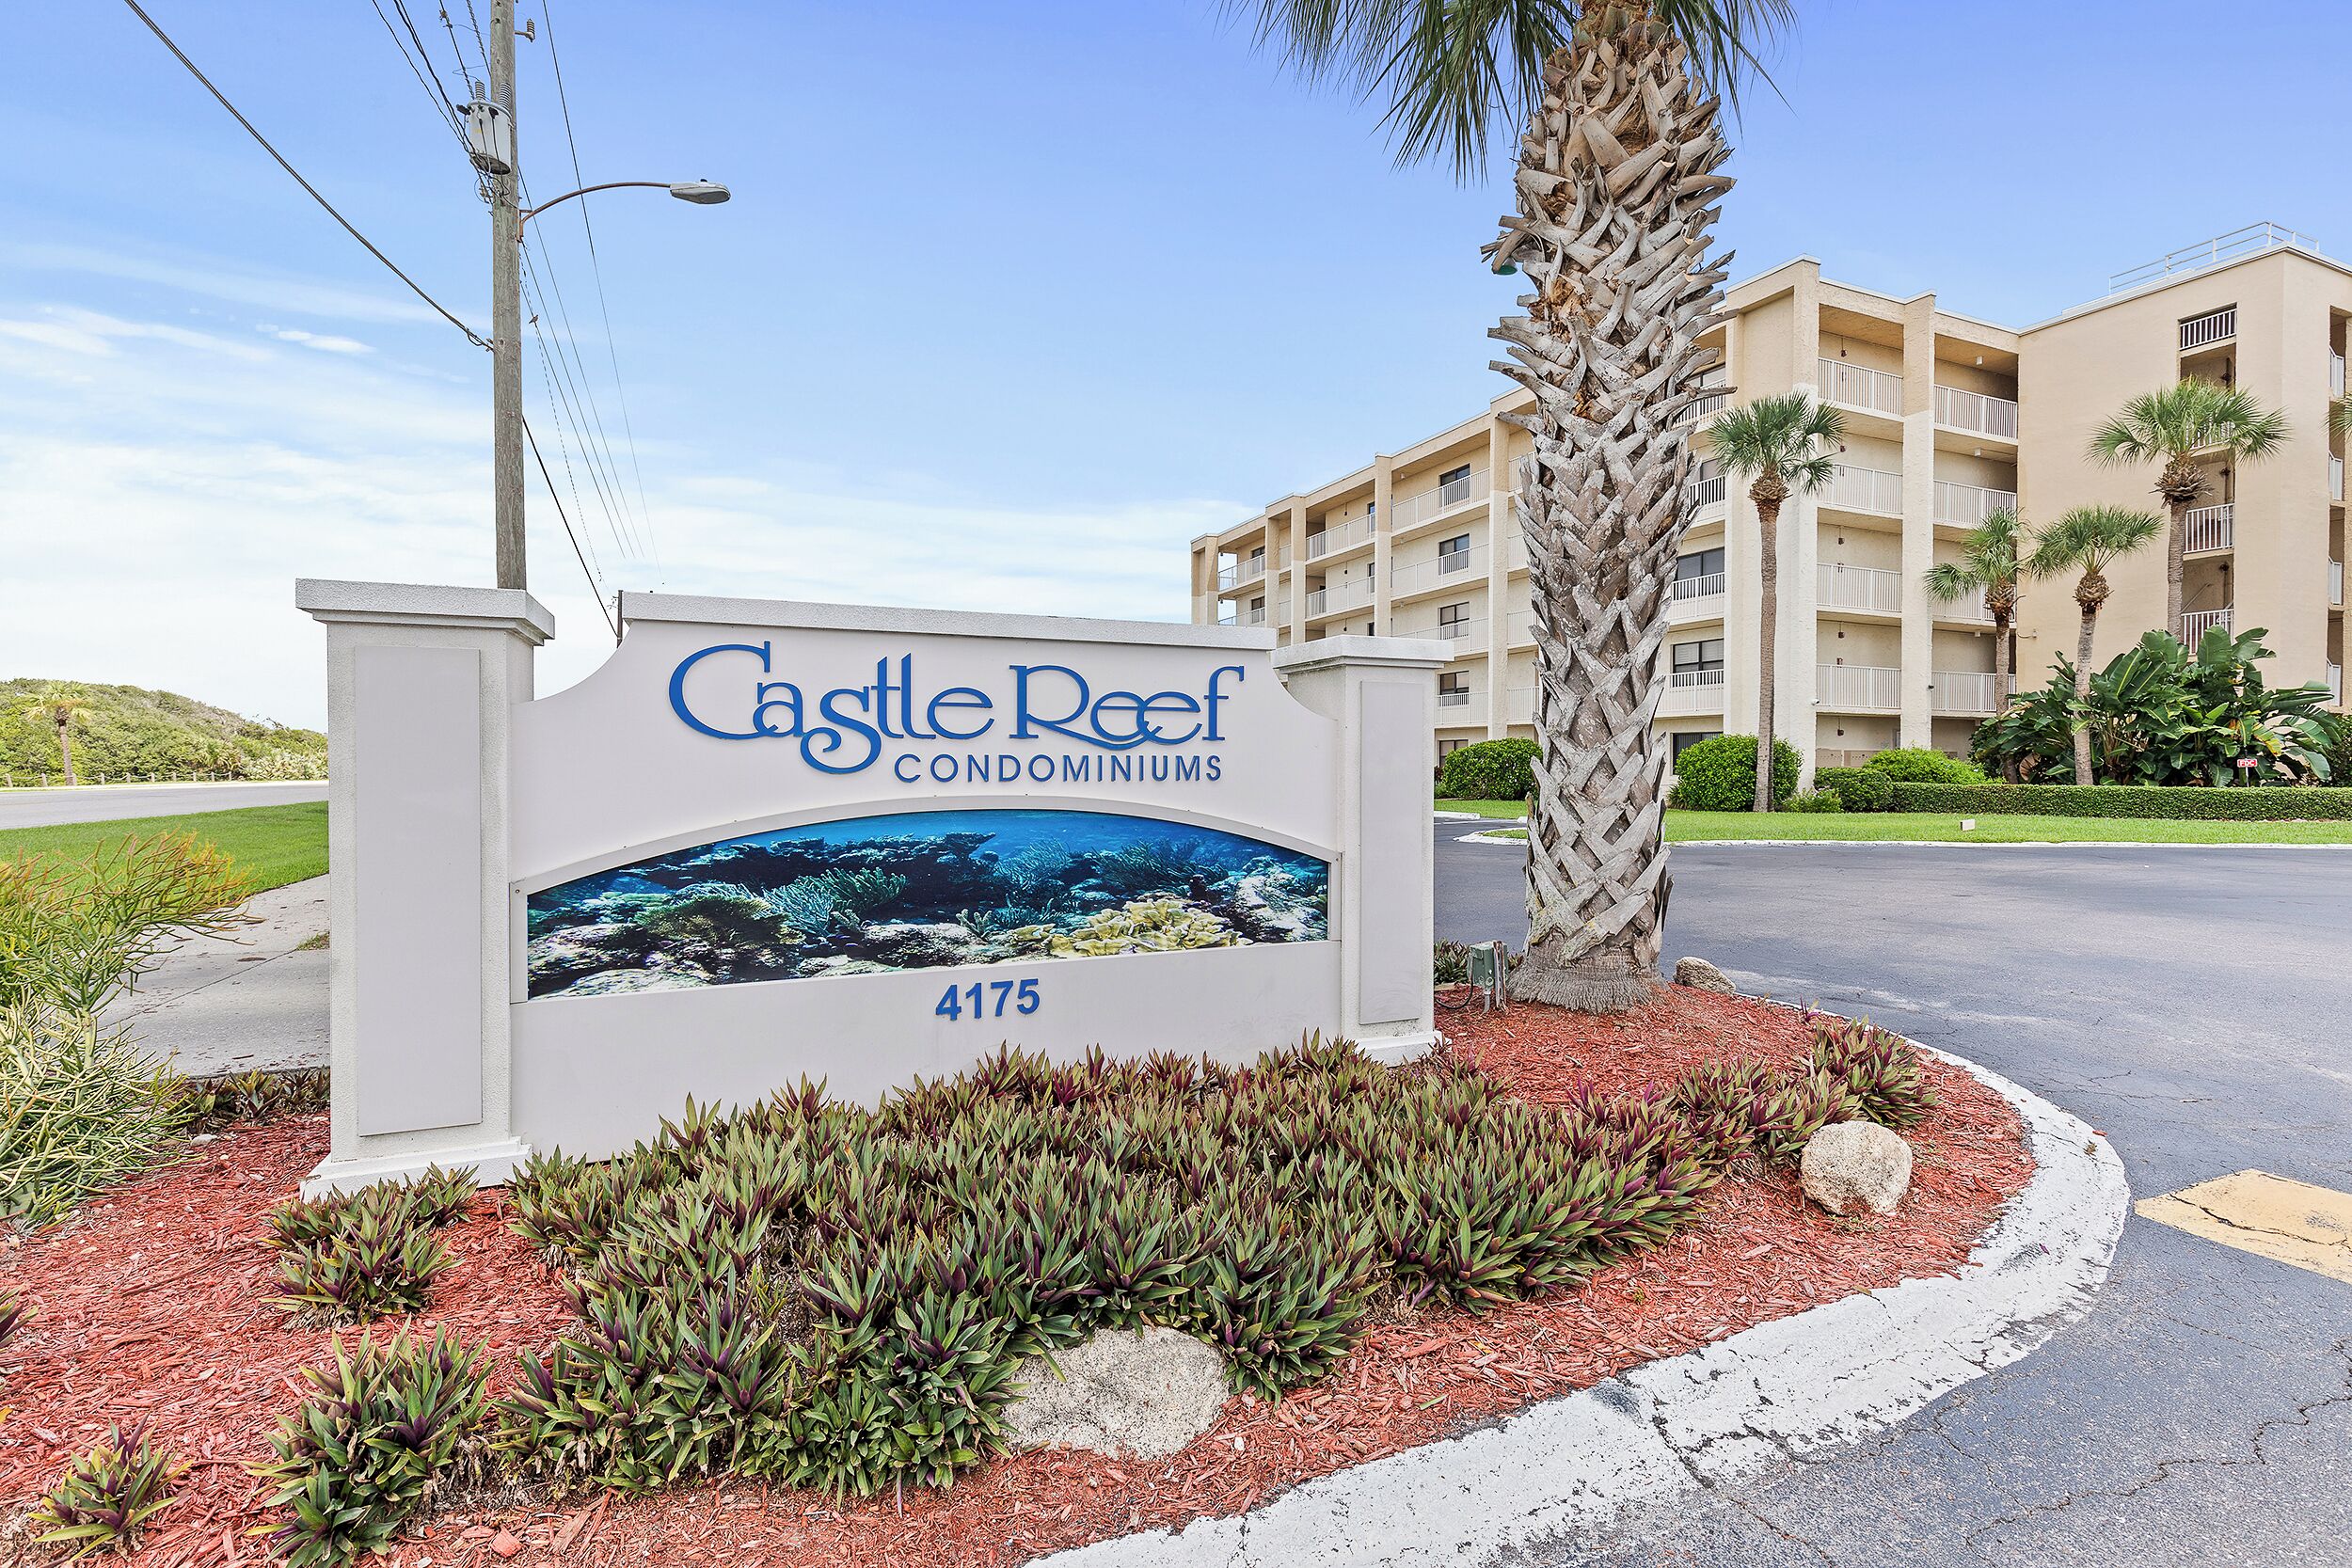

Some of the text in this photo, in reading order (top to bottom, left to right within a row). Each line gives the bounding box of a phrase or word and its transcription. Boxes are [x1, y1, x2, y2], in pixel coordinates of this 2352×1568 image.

[668, 641, 1245, 774] Castle Reef
[894, 753, 1220, 784] CONDOMINIUMS
[935, 978, 1040, 1021] 4175
